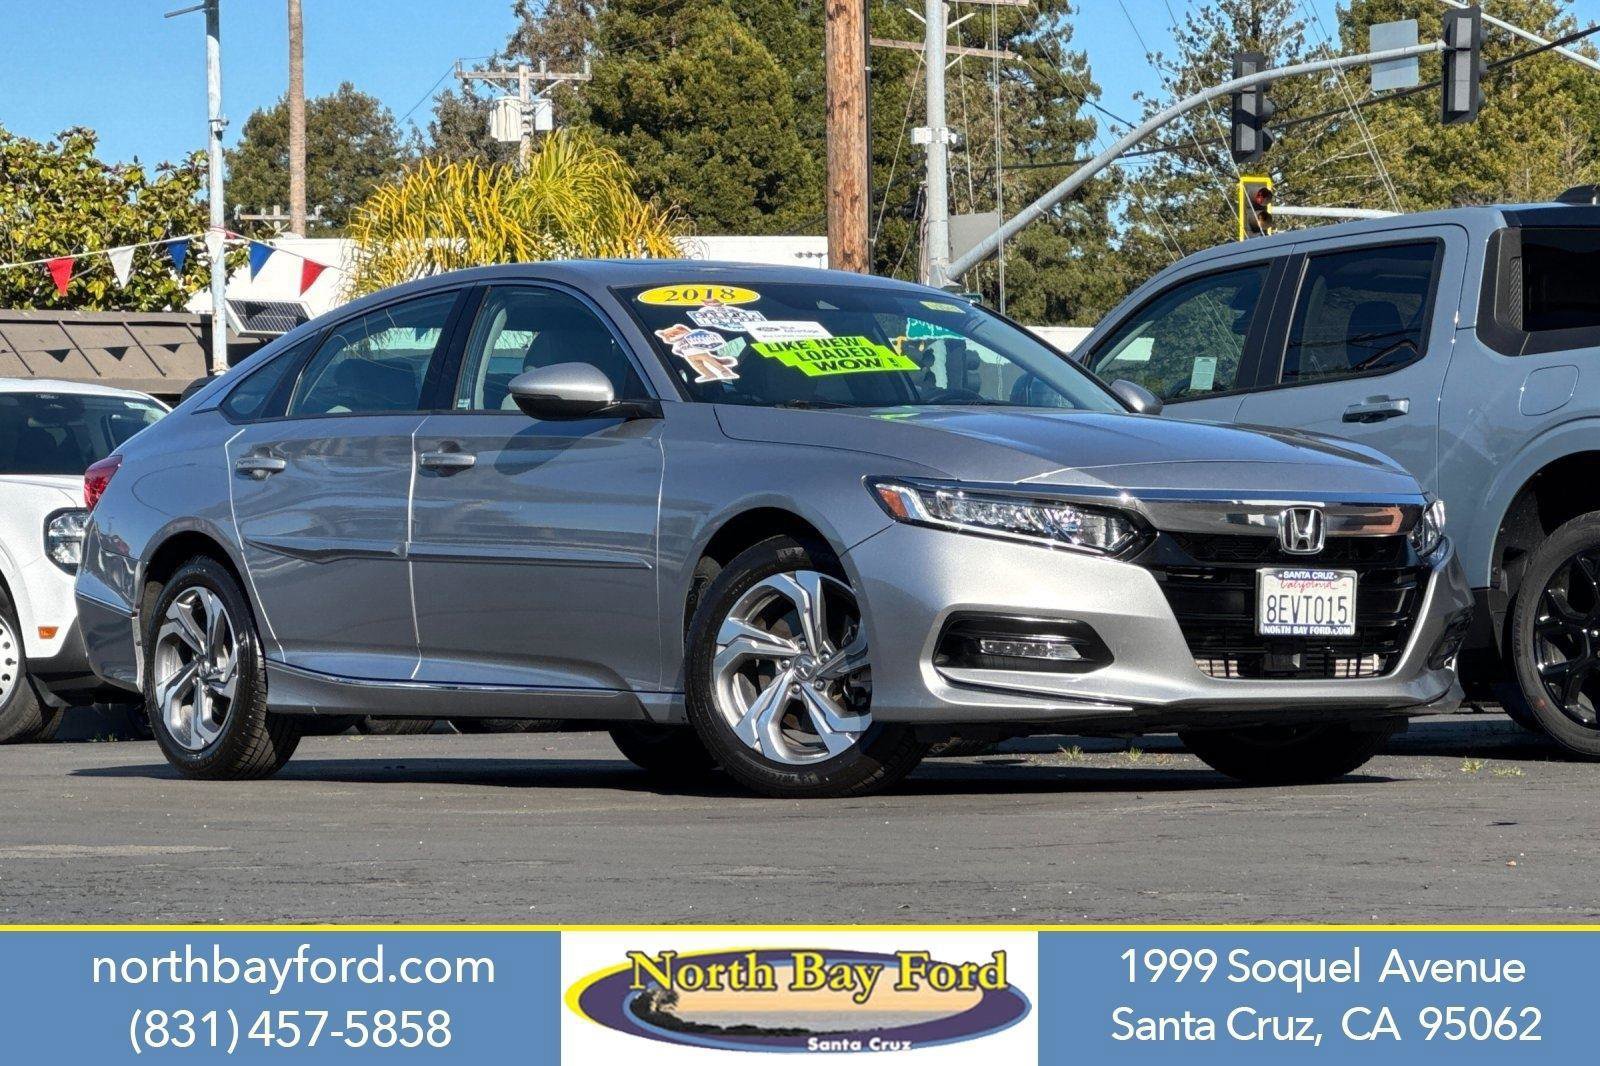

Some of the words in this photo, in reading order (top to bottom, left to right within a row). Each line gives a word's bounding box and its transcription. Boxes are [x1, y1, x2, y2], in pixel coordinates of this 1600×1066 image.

[664, 288, 736, 301] 2018
[764, 339, 809, 353] LIKE
[815, 336, 861, 349] NEW
[795, 346, 878, 362] LOADED
[813, 357, 882, 372] WOW
[1283, 571, 1311, 579] SANTA
[1314, 571, 1334, 579] CRUZ
[1266, 594, 1347, 624] 8EVT015
[1264, 625, 1292, 635] NORTH
[1293, 625, 1308, 635] BAY
[1309, 625, 1351, 635] FORD.COM
